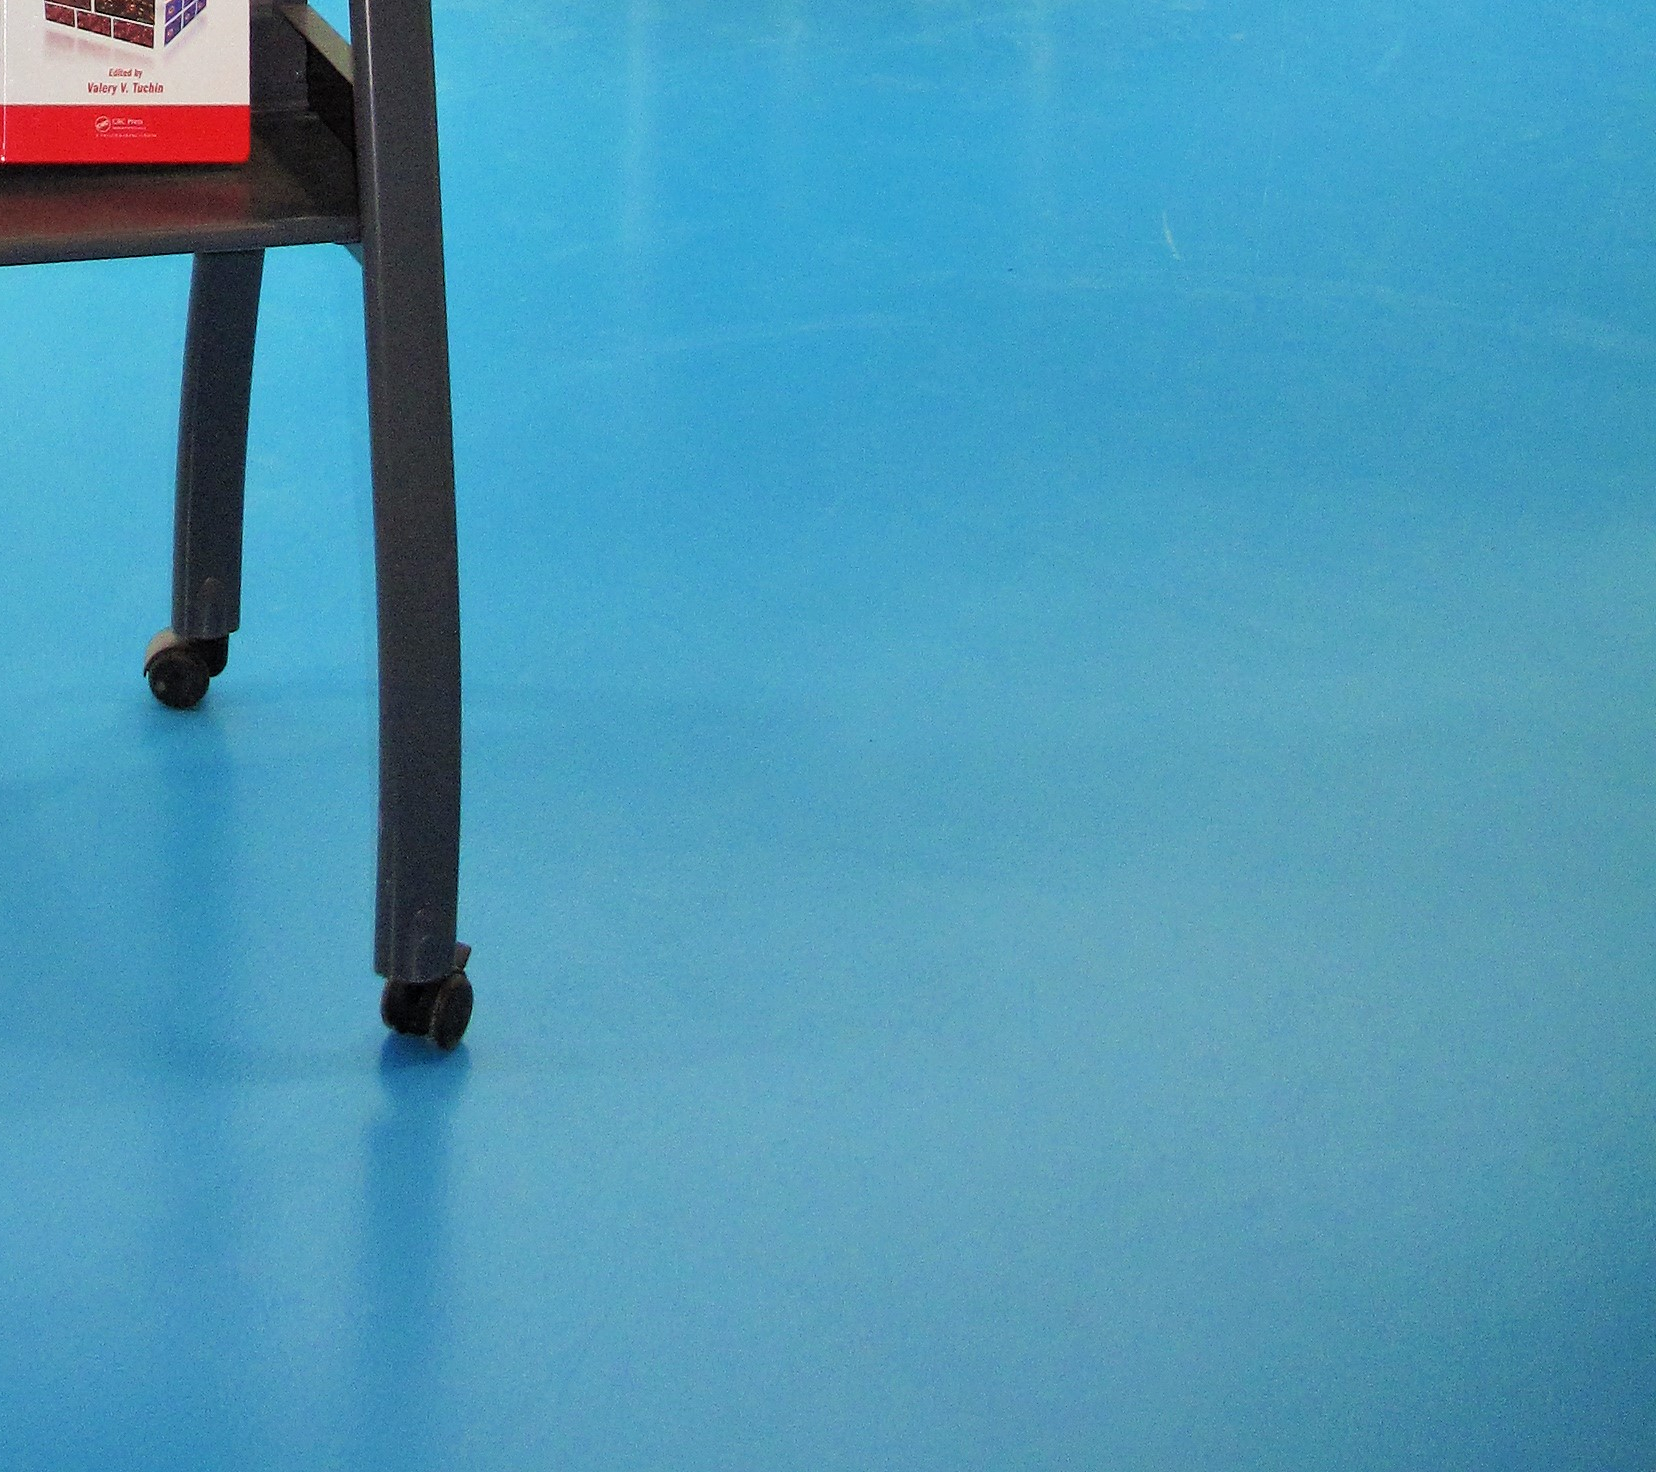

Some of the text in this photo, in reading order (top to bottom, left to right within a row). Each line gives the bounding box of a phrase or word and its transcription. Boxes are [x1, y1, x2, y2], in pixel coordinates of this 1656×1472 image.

[109, 68, 143, 78] Edited by
[88, 82, 164, 95] Valery V. Tuchin
